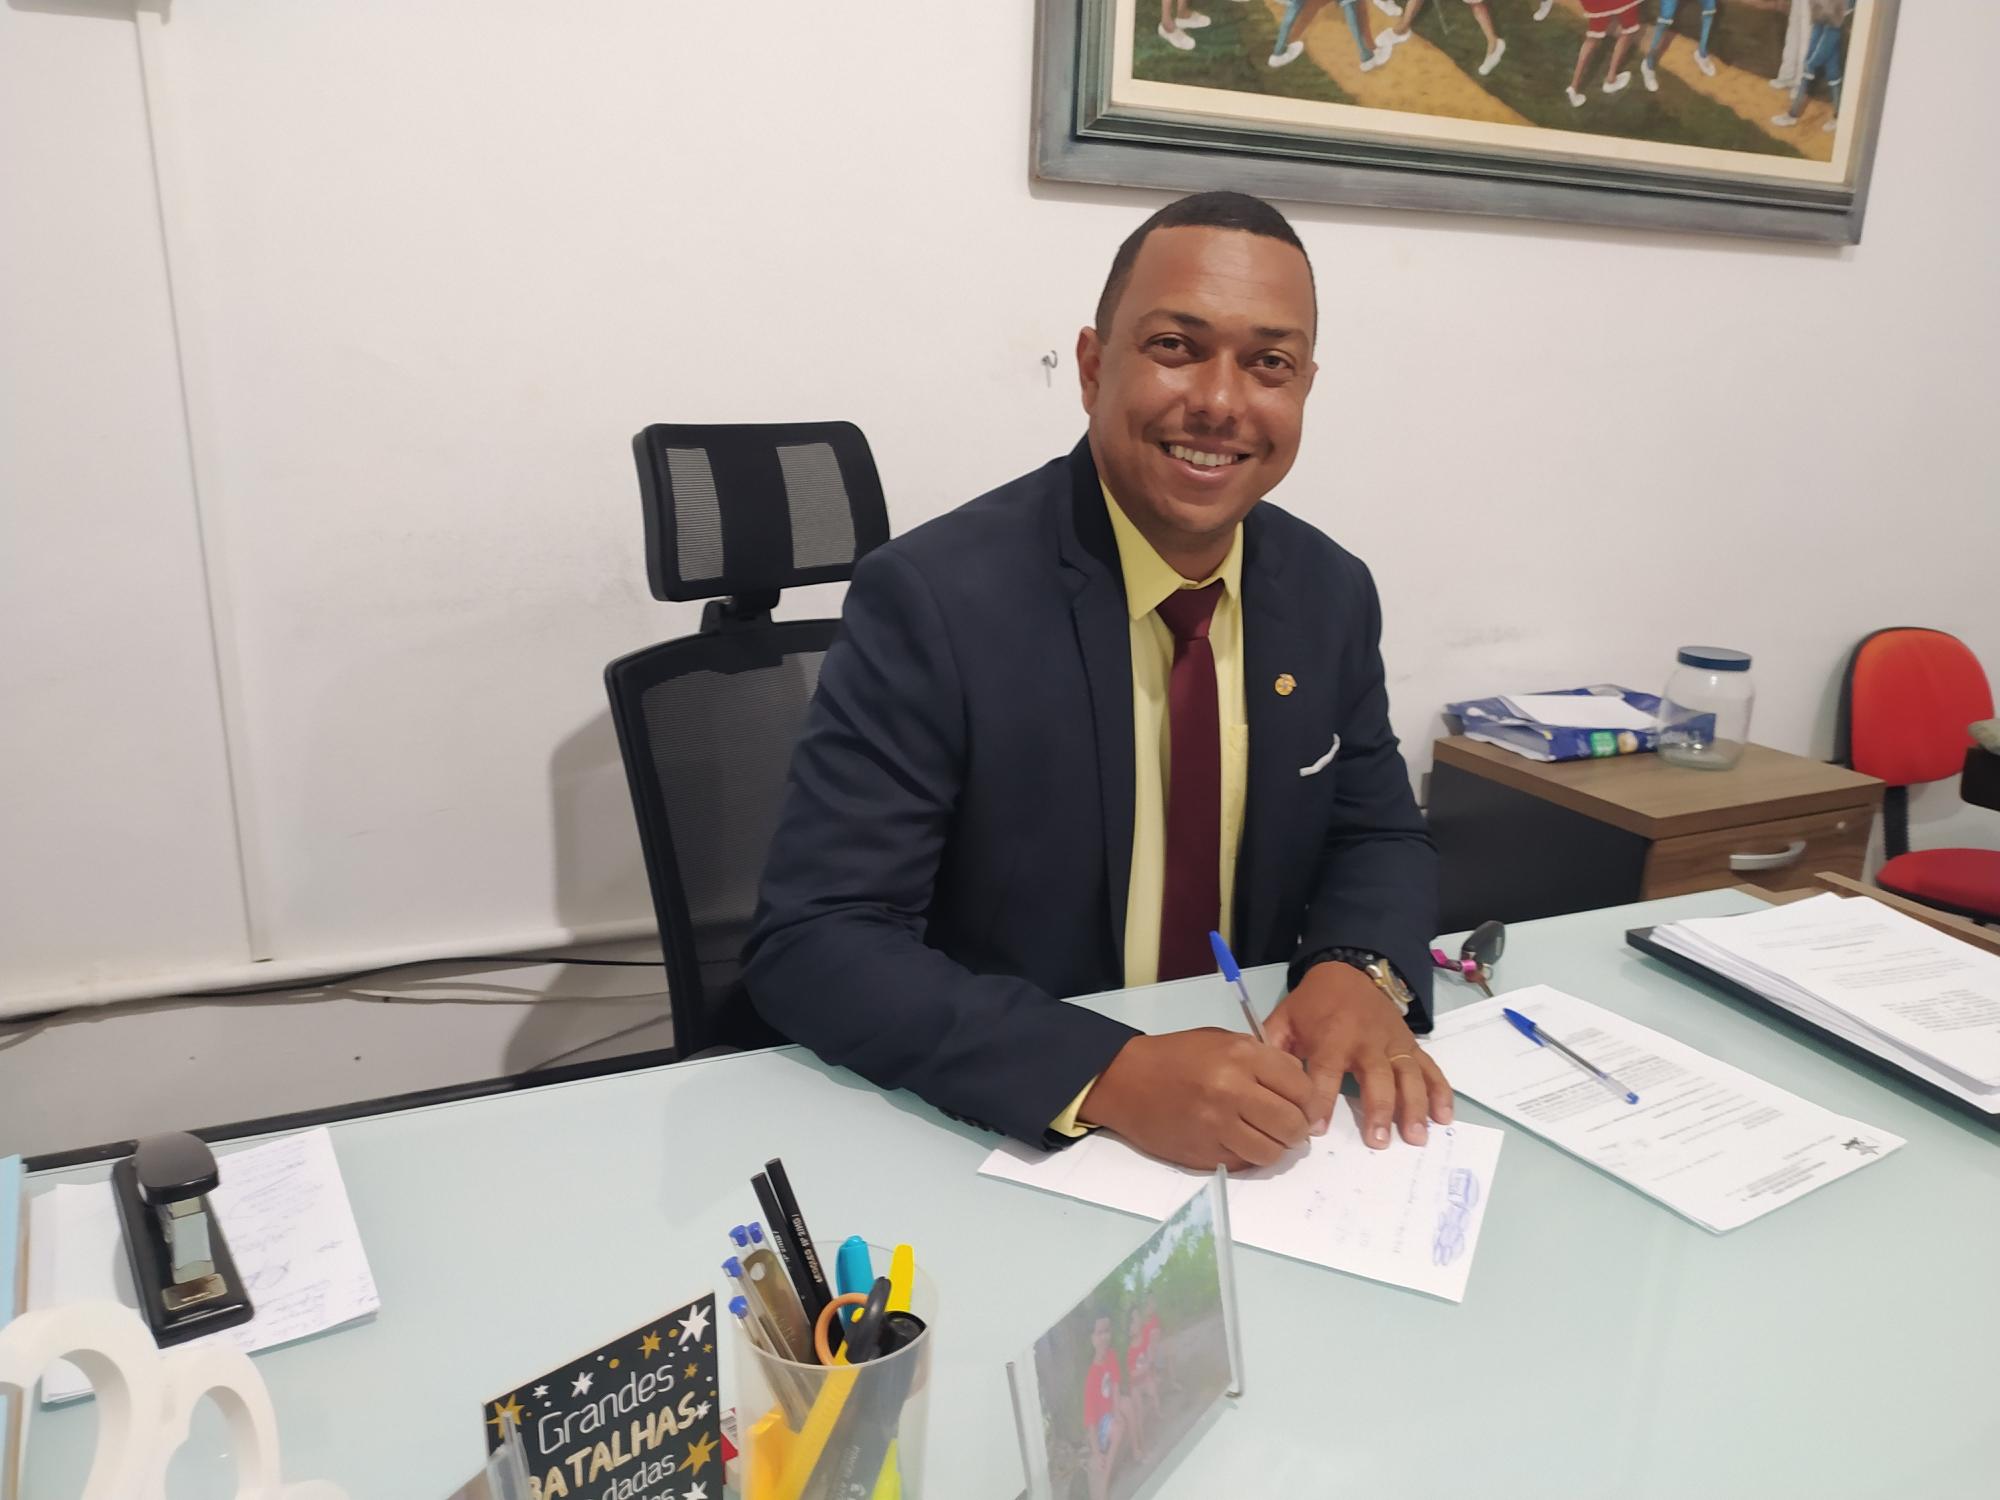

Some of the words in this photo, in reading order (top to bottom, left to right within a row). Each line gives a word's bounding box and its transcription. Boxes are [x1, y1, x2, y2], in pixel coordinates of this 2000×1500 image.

[527, 1391, 697, 1500] BATALHAS
[538, 1364, 675, 1455] Grandes
[602, 1454, 676, 1500] dadas
